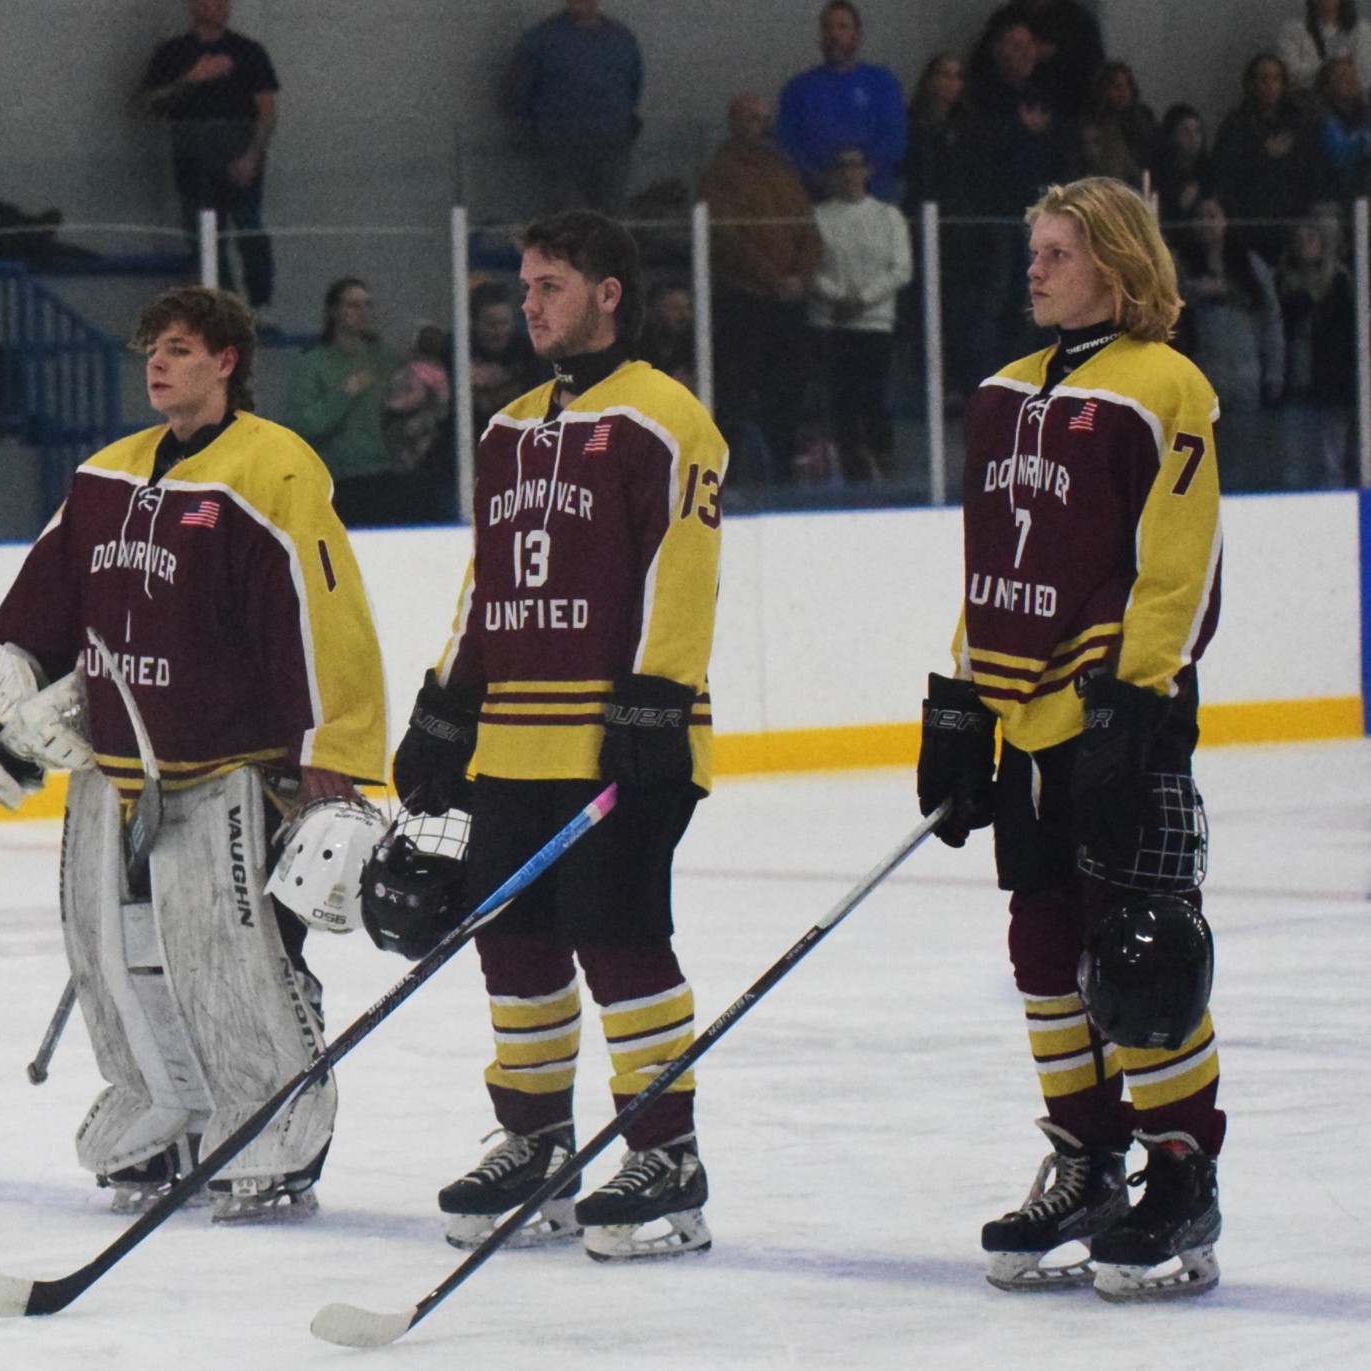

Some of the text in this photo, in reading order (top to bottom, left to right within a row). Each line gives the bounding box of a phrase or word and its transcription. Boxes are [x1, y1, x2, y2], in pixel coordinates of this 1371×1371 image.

[1066, 331, 1124, 354] SHERWOO
[984, 454, 1070, 505] DONRIVER
[1172, 432, 1205, 496] 7
[489, 479, 593, 526] DONRIVER
[680, 463, 721, 529] 13
[318, 539, 337, 592] 1
[514, 529, 551, 588] 13
[1015, 508, 1032, 569] 7
[228, 805, 255, 928] VAUGHN
